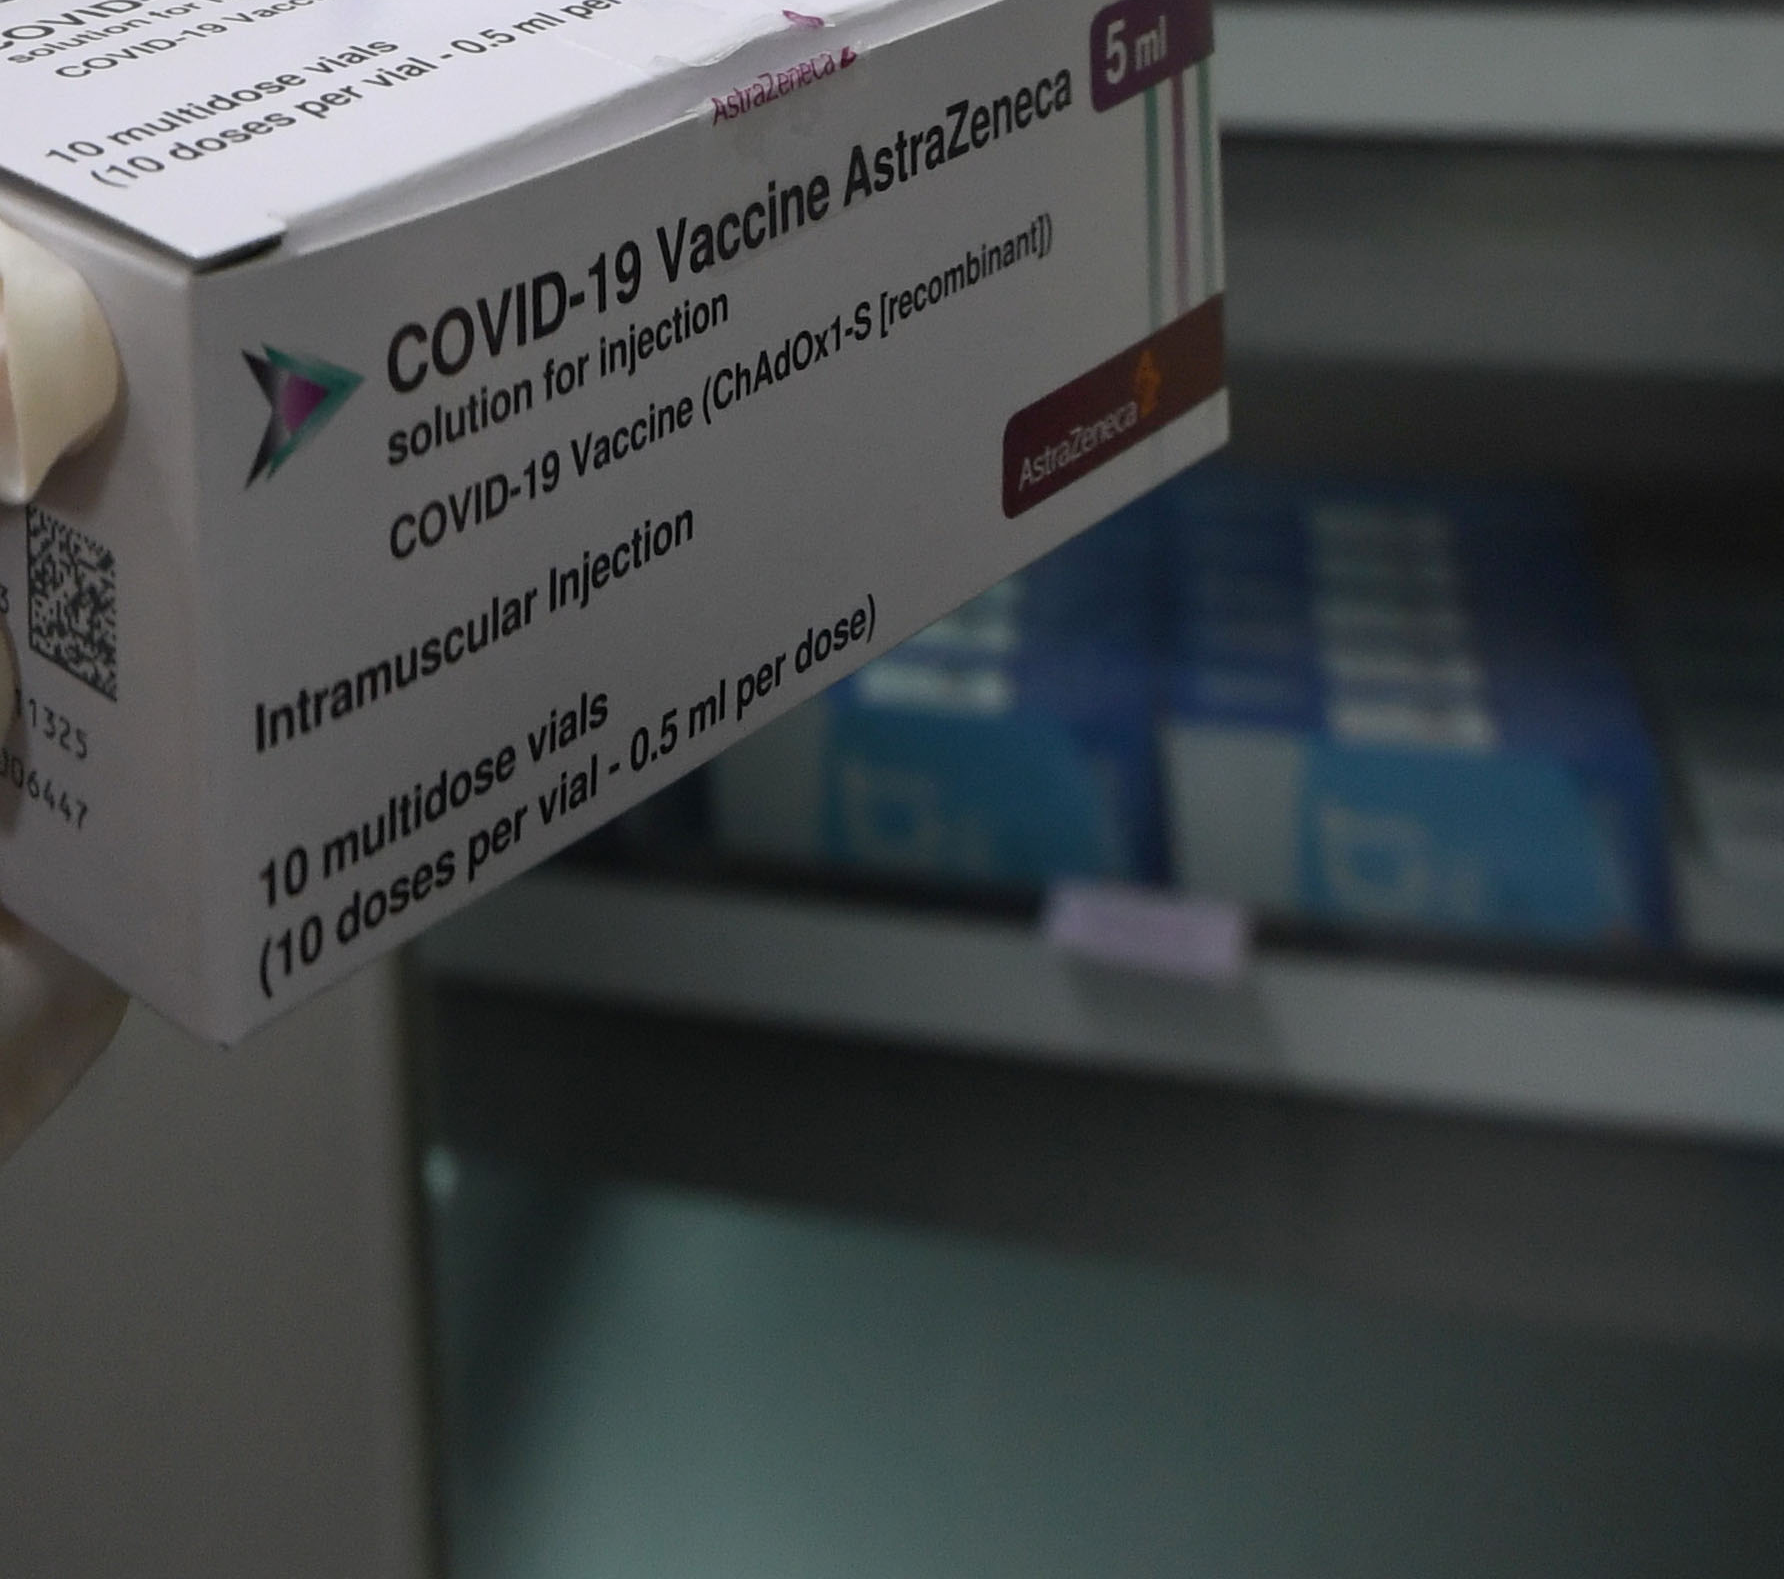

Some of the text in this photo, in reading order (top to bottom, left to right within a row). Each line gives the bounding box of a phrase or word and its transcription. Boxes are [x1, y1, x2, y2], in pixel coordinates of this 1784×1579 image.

[7, 12, 151, 65] solution
[150, 0, 204, 21] for
[45, 38, 399, 165] 10 multidose vials
[54, 21, 229, 79] COVID-19
[89, 154, 165, 190] (10
[169, 108, 296, 163] doses
[294, 84, 364, 120] per
[361, 56, 438, 89] vial
[450, 27, 517, 57] 0.5
[512, 11, 566, 35] ml
[712, 51, 836, 127] AstraZeneca
[1104, 14, 1167, 86] 5 ml
[386, 67, 1073, 395] COVID-19 Vaccine AstraZeneca
[387, 290, 729, 467] solution for injection
[389, 211, 1053, 561] COVID-19 Vaccine (ChAdOx1-S [recombinant])
[1018, 399, 1138, 492] AstraZeneca
[254, 508, 694, 754] Intramuscular Injection
[258, 914, 324, 999] (10
[334, 847, 457, 944] doses
[467, 803, 528, 883] per
[538, 753, 599, 826] vial
[629, 707, 678, 773] 0.5
[687, 678, 726, 739] ml
[736, 652, 787, 722] per
[794, 593, 876, 674] dose)
[258, 690, 609, 910] 10 multidose vials
